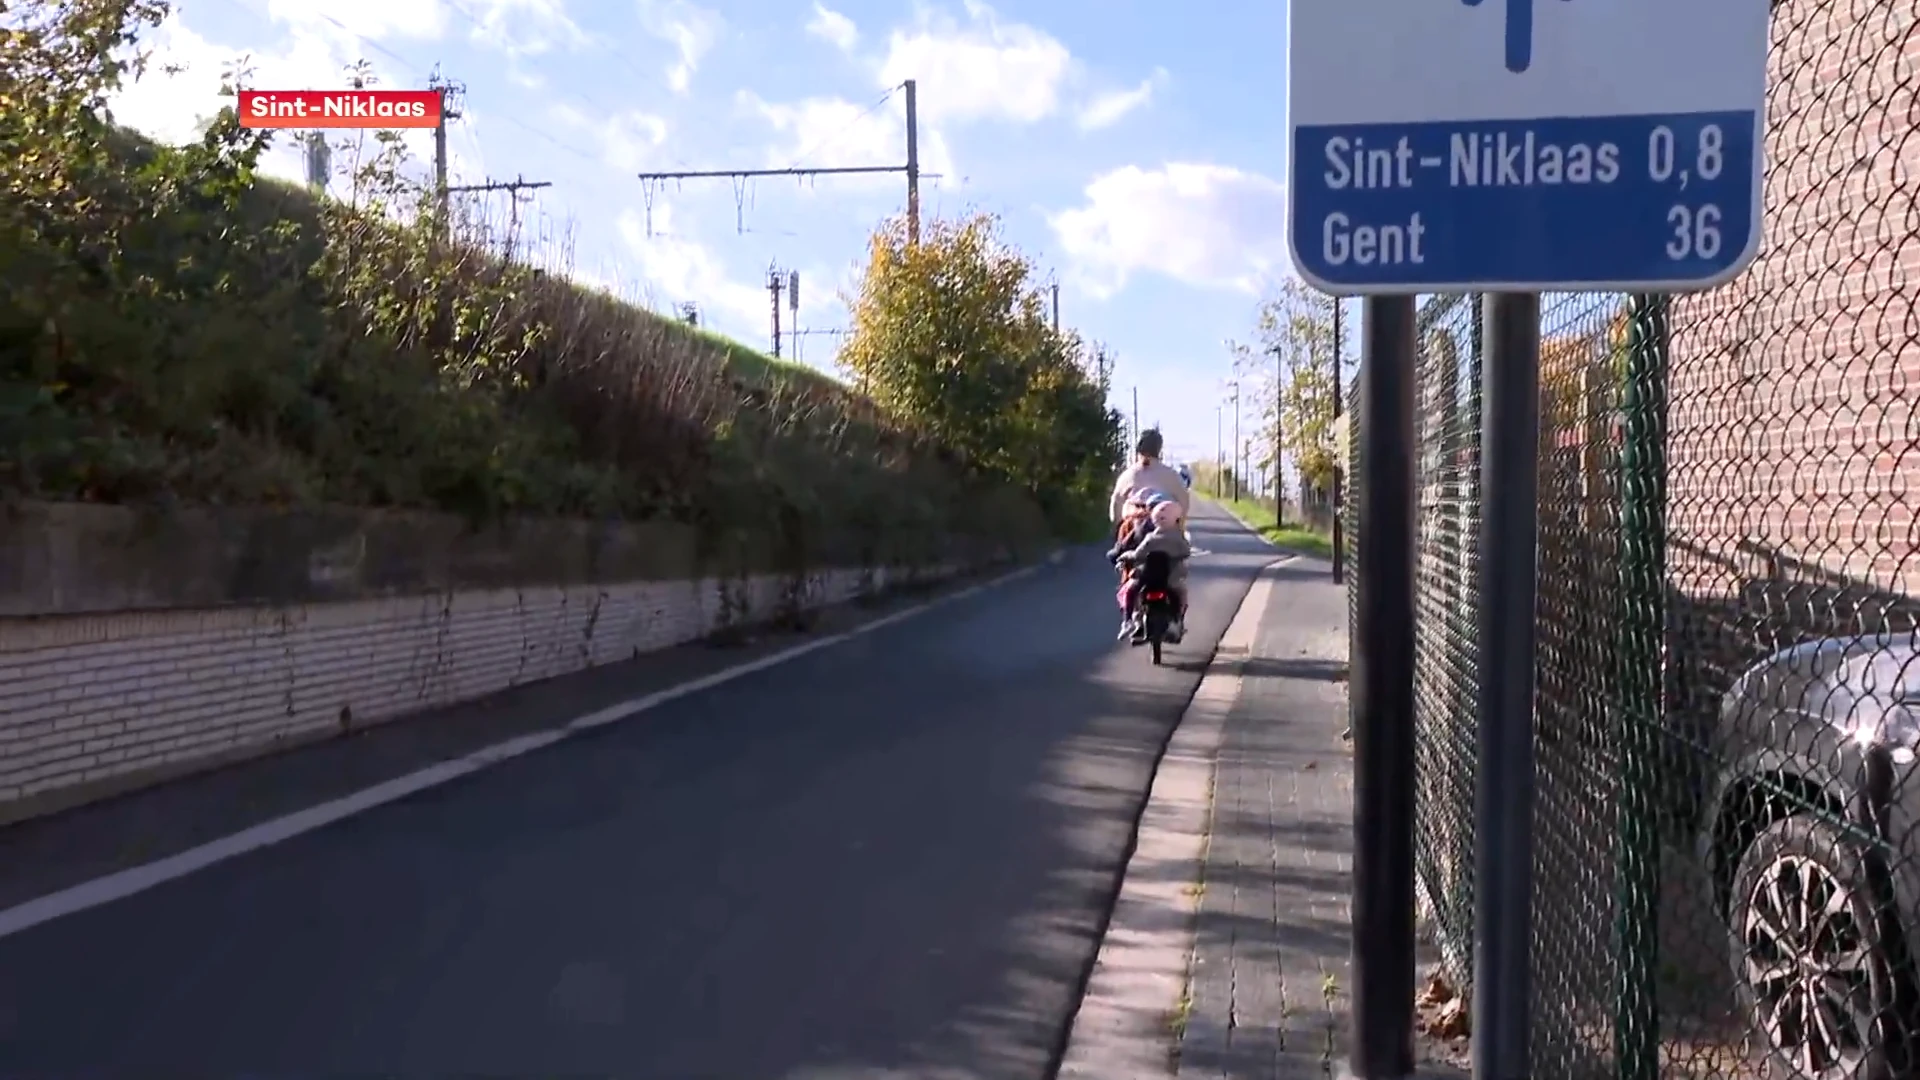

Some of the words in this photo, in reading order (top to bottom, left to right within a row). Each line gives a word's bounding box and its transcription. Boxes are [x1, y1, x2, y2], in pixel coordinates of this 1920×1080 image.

[1324, 131, 1620, 189] Sint-Niklaas
[1648, 124, 1723, 190] 0,8
[1323, 211, 1425, 265] Gent
[1666, 204, 1721, 260] 36
